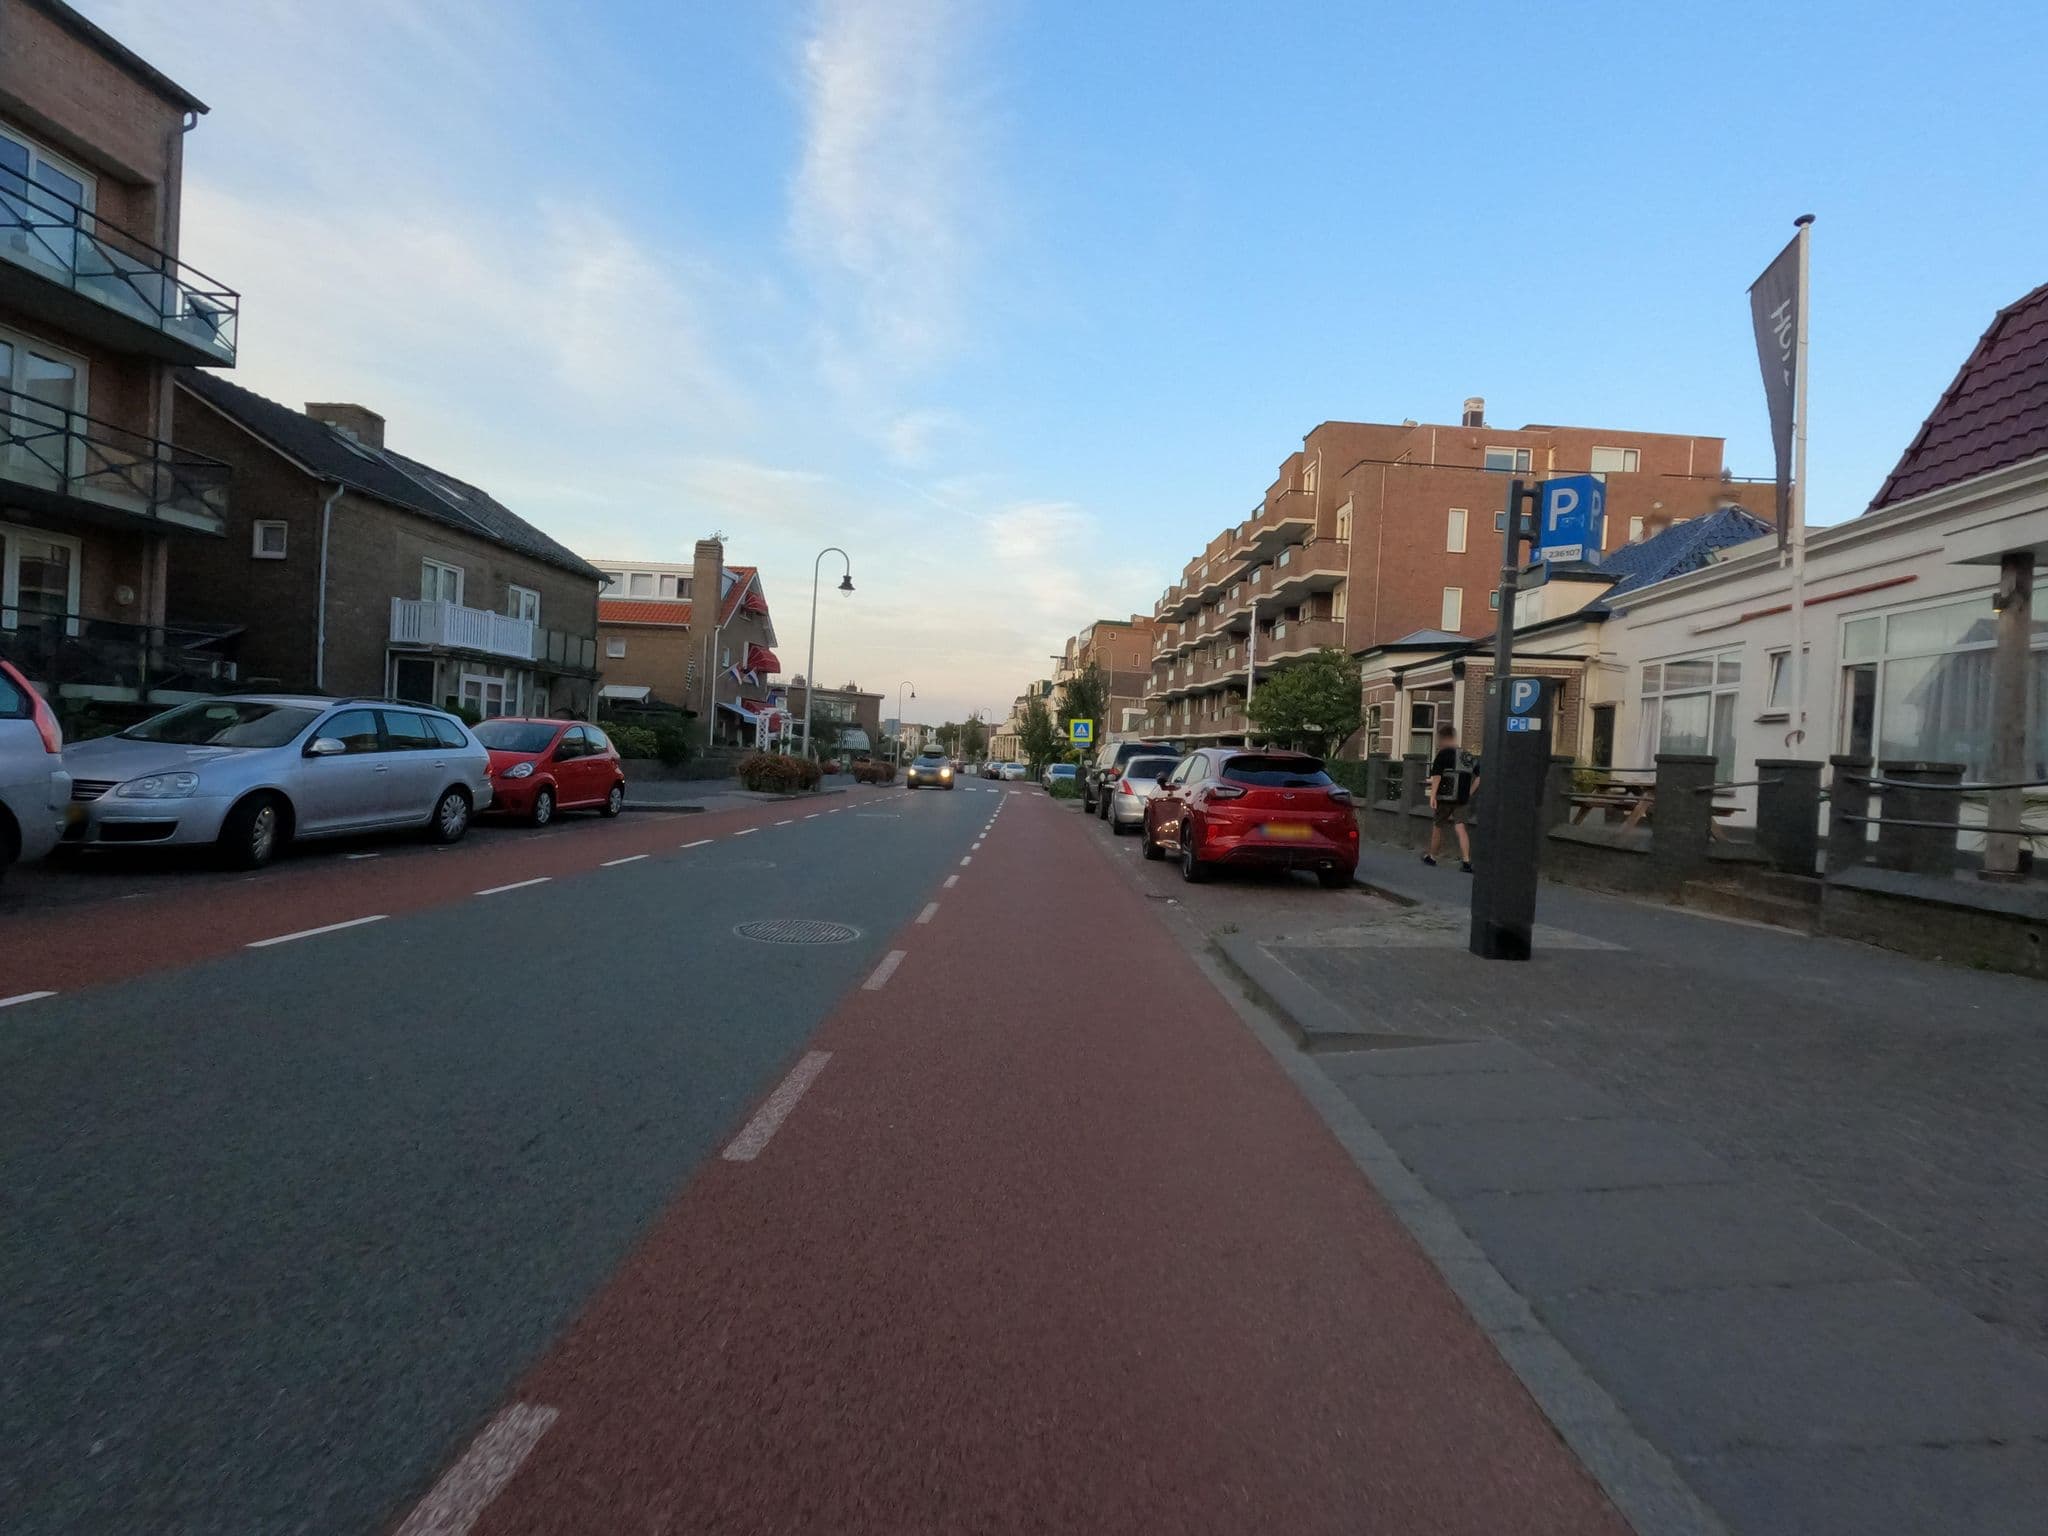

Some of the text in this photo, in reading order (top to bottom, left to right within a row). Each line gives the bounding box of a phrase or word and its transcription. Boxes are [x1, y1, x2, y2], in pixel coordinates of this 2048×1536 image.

[1549, 488, 1579, 531] P
[1515, 682, 1532, 707] P
[1510, 718, 1518, 730] P
